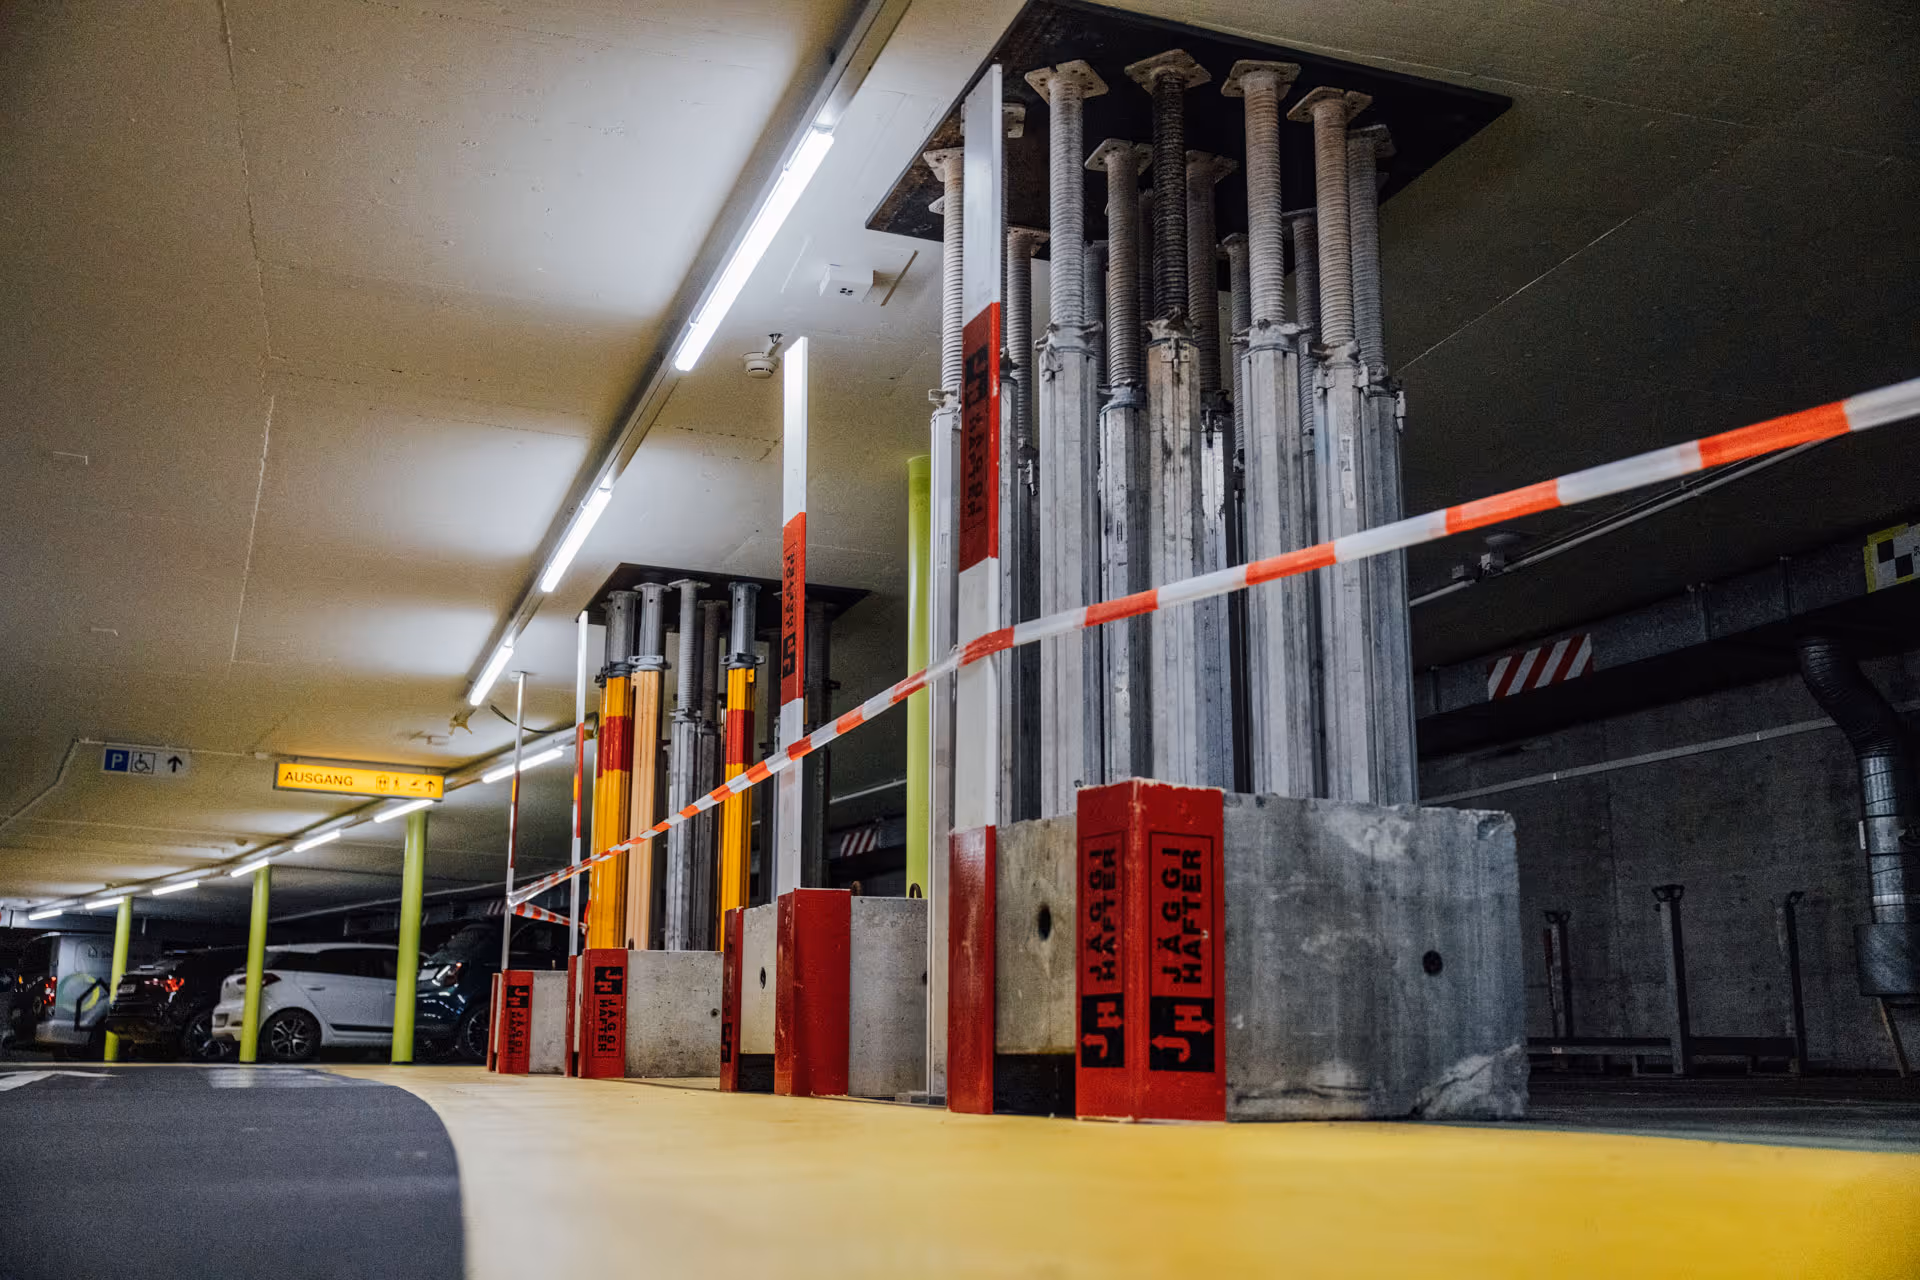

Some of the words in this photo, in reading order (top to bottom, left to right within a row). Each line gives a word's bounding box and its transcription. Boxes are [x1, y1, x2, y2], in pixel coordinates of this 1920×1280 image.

[110, 753, 123, 769] P
[283, 770, 354, 788] AUSGANG
[1101, 847, 1117, 982] HAFTER
[1157, 847, 1182, 984] JÄGGI
[1181, 848, 1203, 985] HAFTER
[597, 1000, 608, 1053] HAFTER
